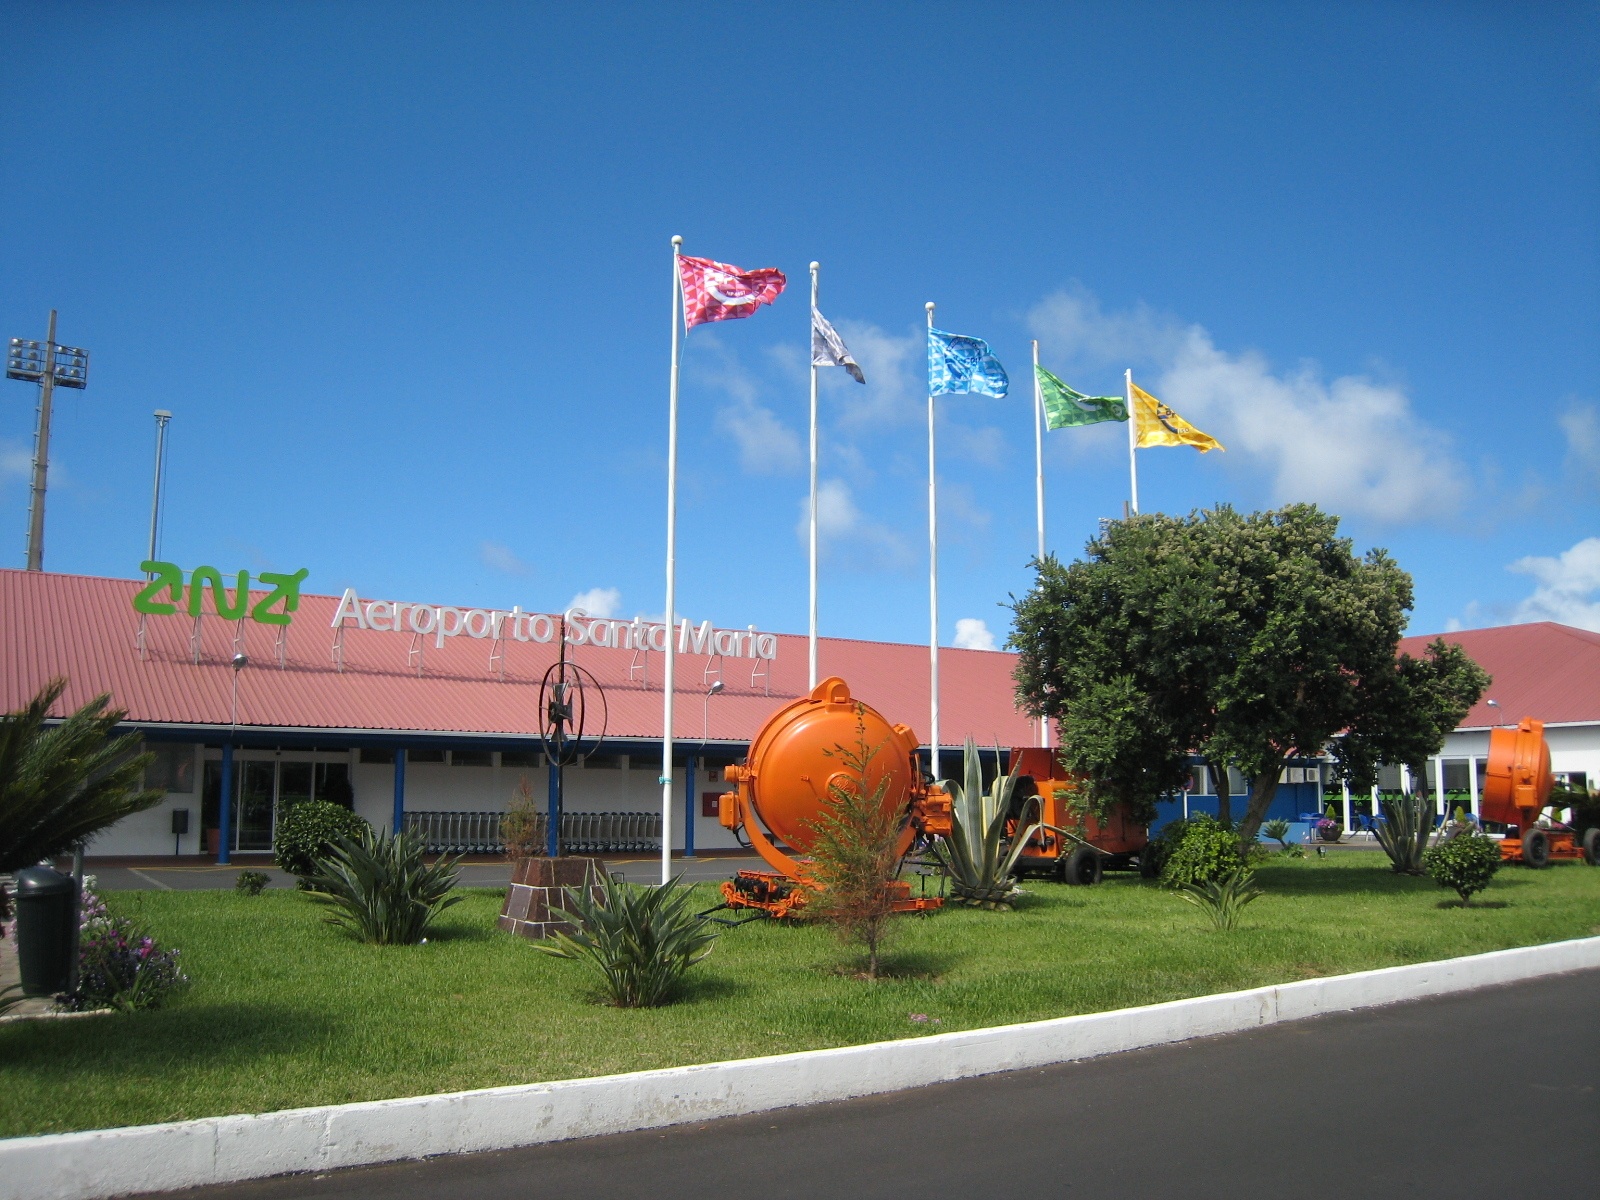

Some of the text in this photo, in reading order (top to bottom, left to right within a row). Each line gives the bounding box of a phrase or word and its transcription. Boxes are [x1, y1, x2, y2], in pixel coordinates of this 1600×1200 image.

[331, 587, 778, 661] Aeroporto Santa Maria
